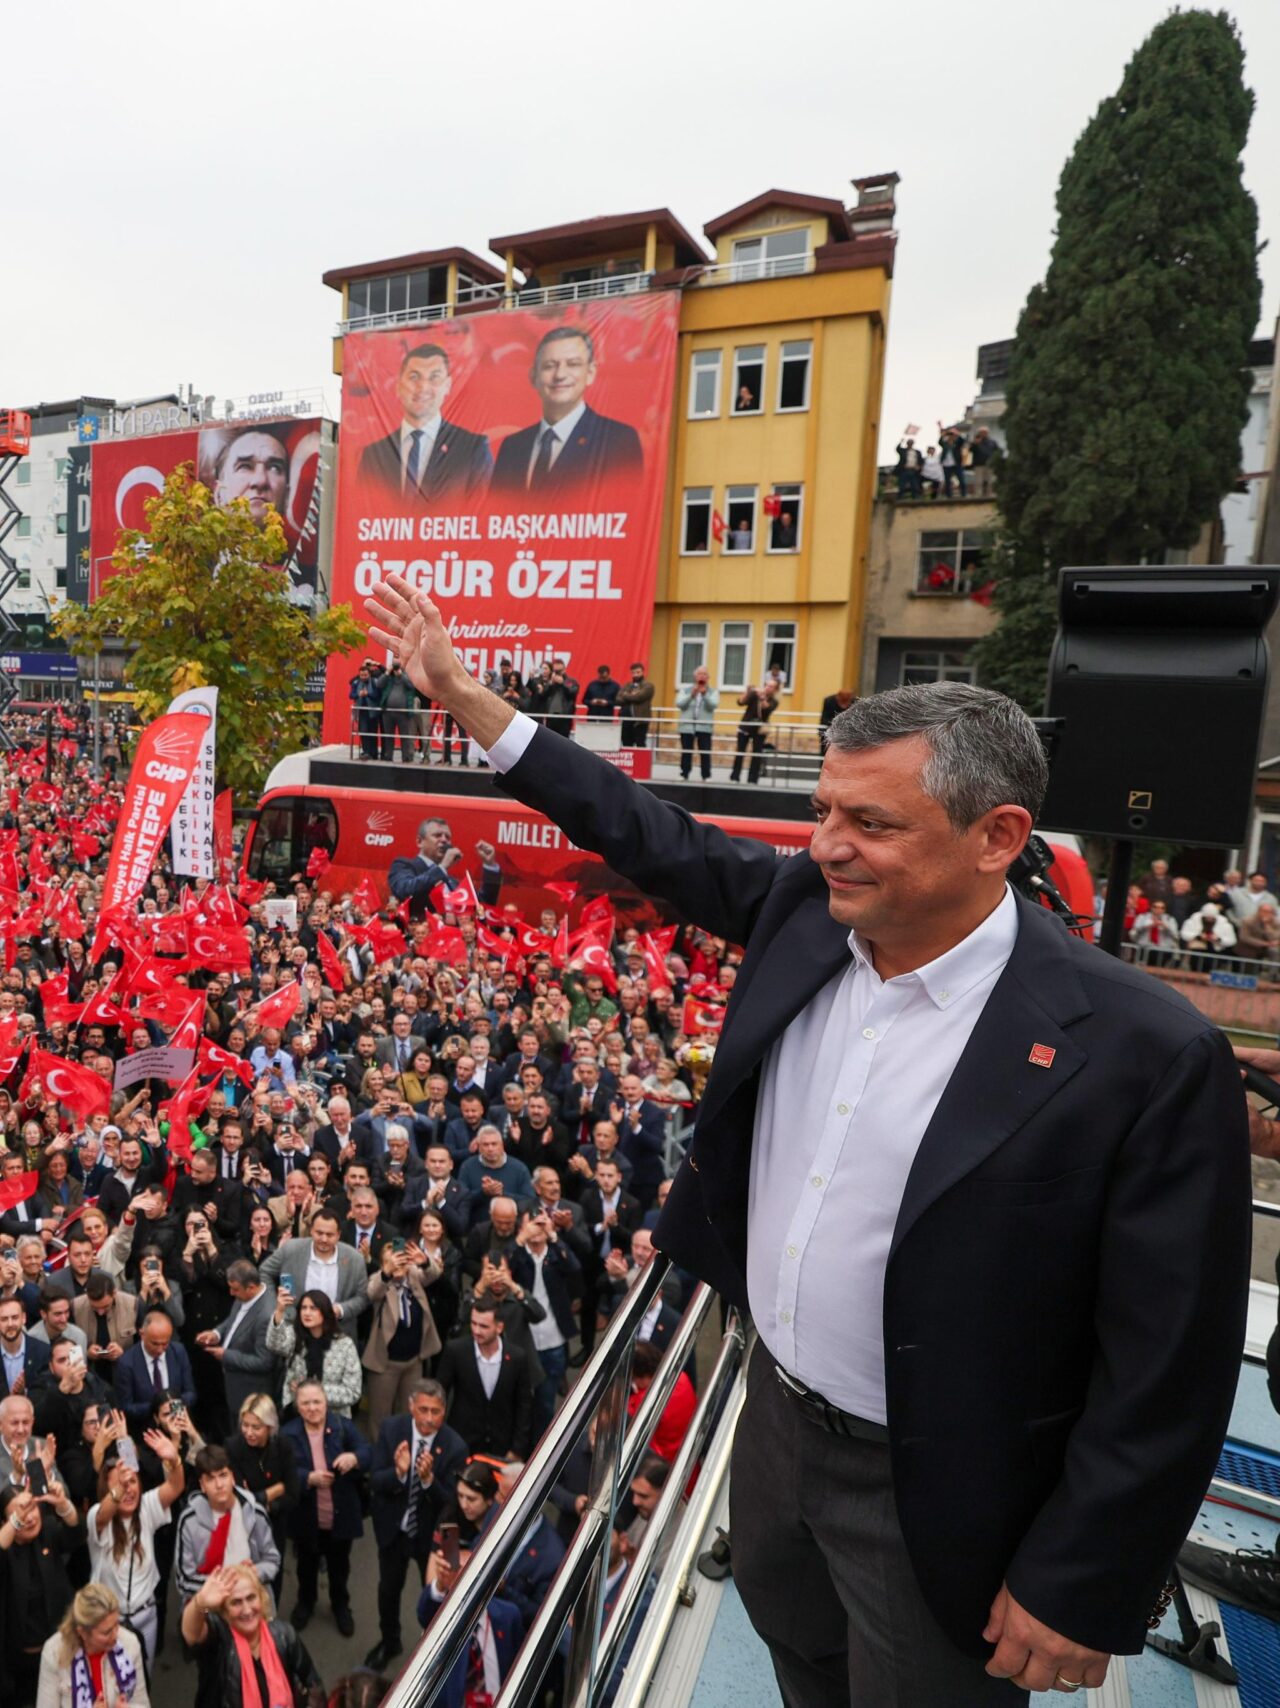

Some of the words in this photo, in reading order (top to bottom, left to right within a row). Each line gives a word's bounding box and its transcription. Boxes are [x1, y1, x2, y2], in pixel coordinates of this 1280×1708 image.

[358, 517, 414, 541] SAYIN
[419, 515, 481, 540] GENEL
[488, 513, 627, 544] BAŞKANIMIZ
[507, 550, 622, 599] ÖZEL
[446, 615, 531, 639] hrimize
[455, 643, 572, 686] ELDİNİZ
[145, 760, 187, 783] CHP
[128, 784, 147, 828] Partisi
[204, 745, 213, 876] SENDİKASI
[121, 829, 136, 860] Halk
[365, 833, 394, 846] CHP
[111, 862, 129, 905] uriyet
[1032, 1057, 1048, 1065] CHP
